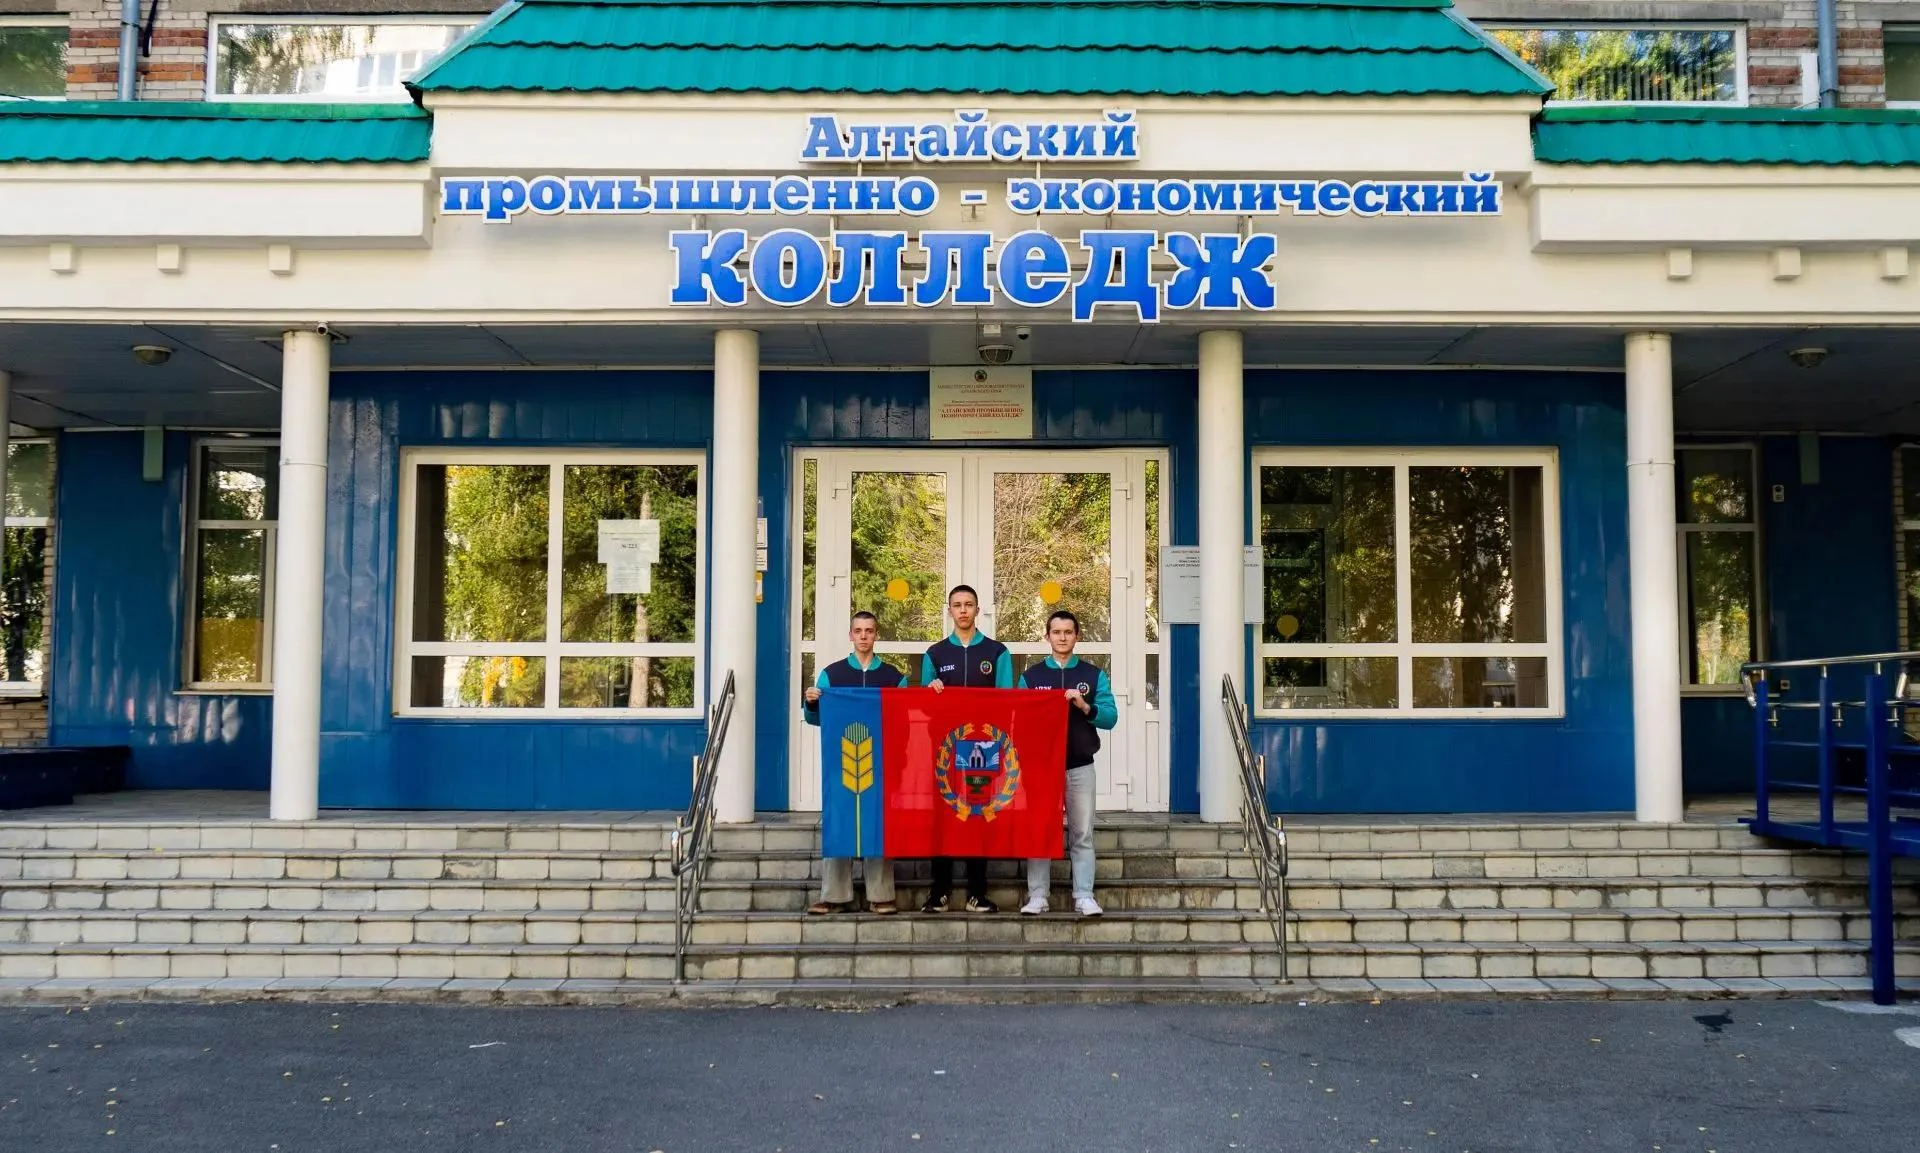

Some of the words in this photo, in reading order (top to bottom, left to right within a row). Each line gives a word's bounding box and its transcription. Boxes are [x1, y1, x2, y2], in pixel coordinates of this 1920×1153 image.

[801, 109, 1139, 162] Алтайский
[441, 176, 938, 222] промышленно
[1008, 171, 1501, 214] экономический
